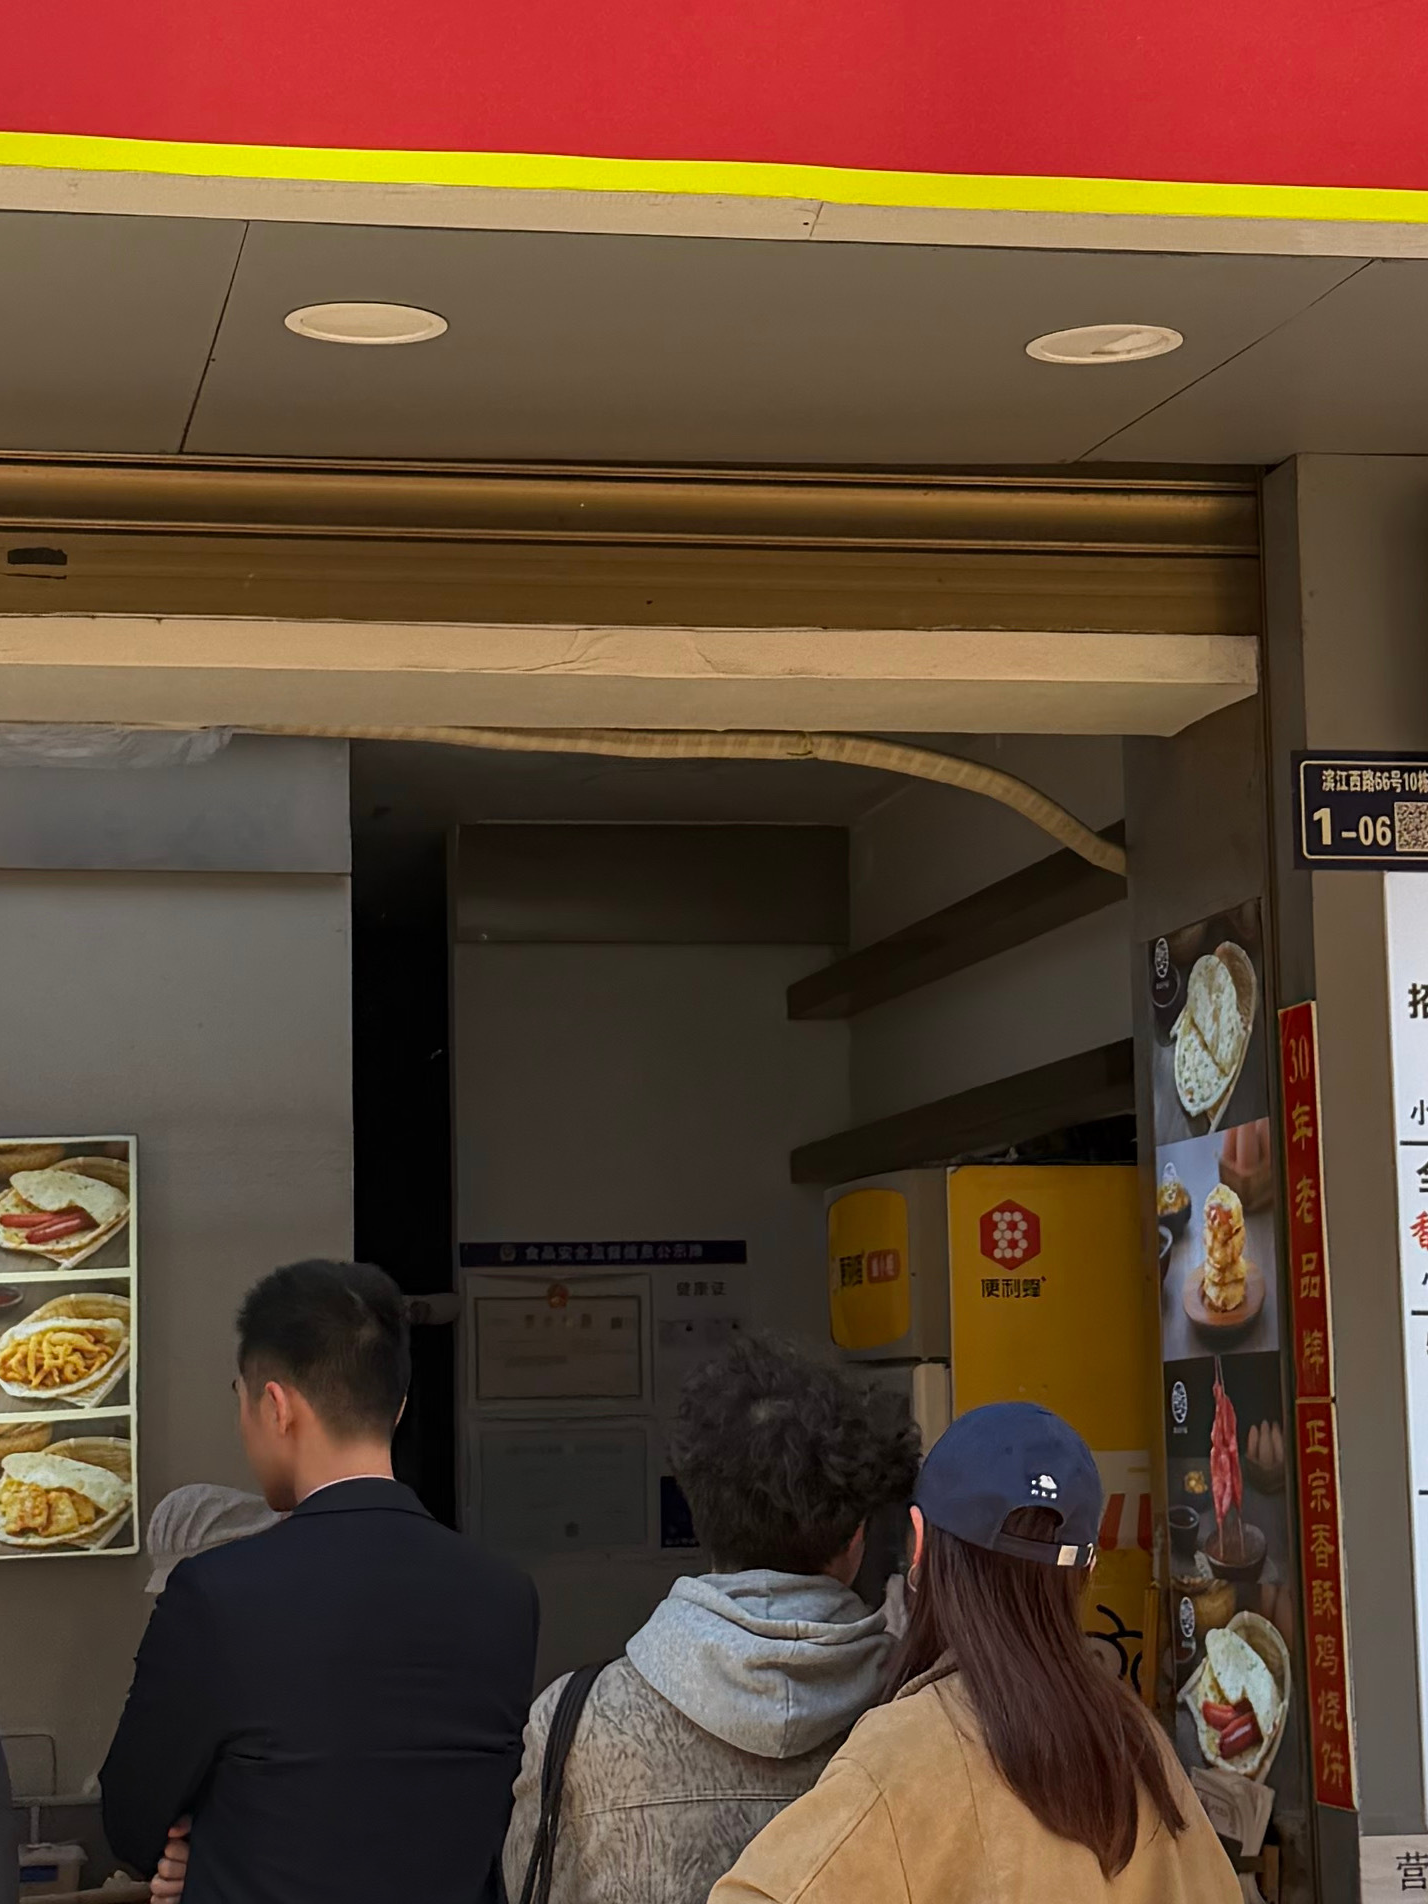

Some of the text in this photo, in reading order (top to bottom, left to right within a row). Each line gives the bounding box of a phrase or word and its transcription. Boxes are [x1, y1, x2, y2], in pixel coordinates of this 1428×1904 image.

[981, 1277, 1041, 1299] 便利蜂
[1288, 1038, 1325, 1375] 30年老品牌
[1305, 1419, 1346, 1789] 正宗香酥鸡烧饼
